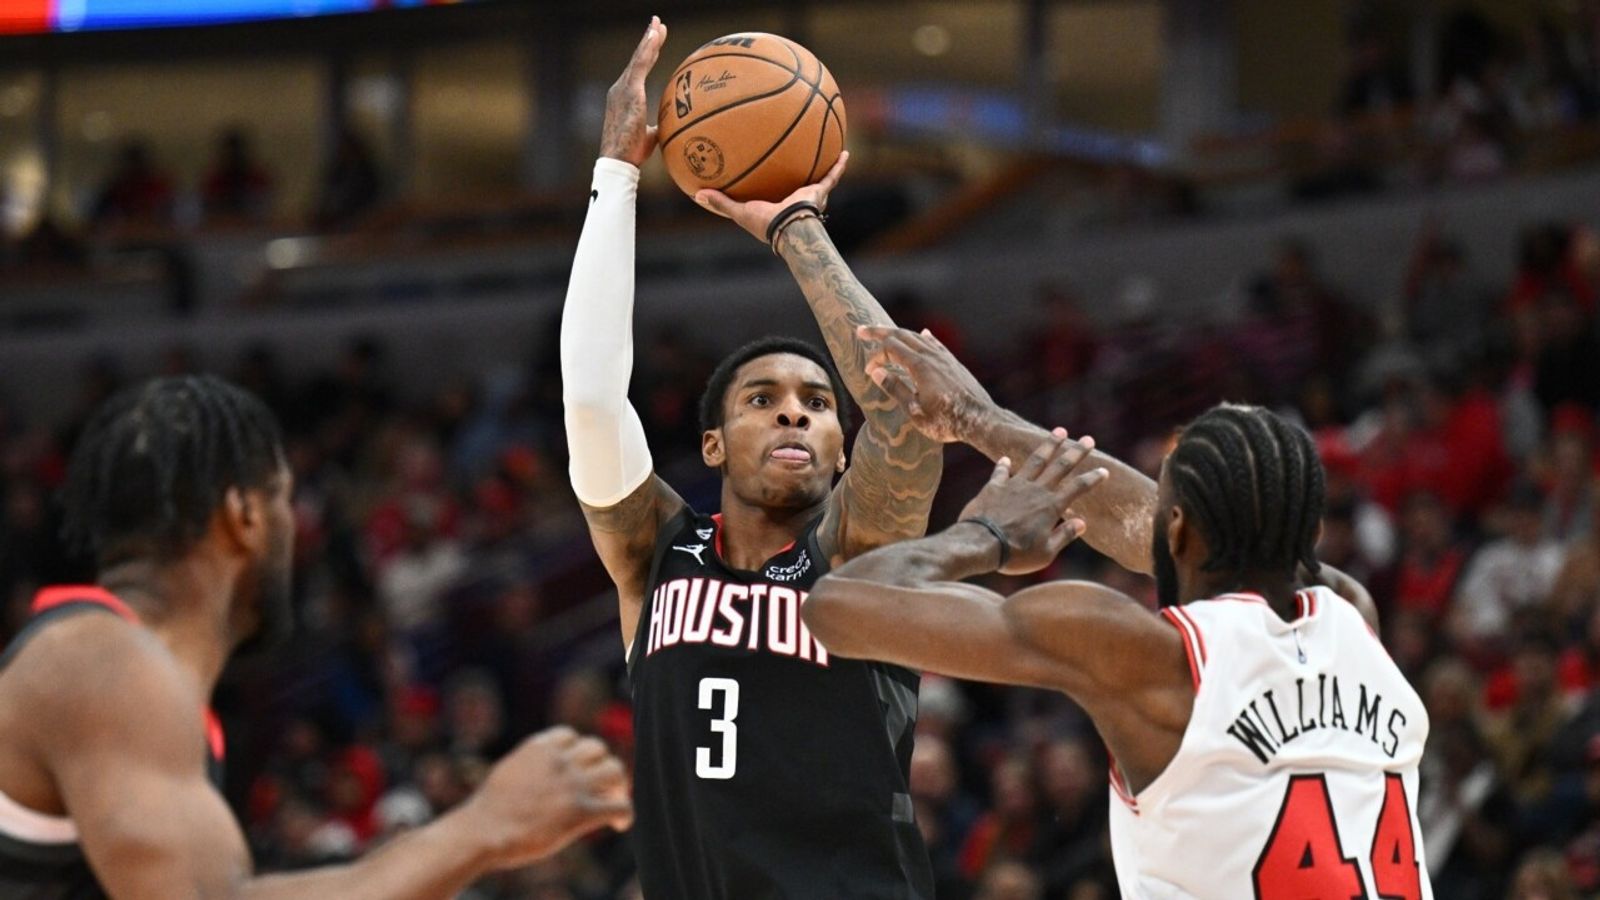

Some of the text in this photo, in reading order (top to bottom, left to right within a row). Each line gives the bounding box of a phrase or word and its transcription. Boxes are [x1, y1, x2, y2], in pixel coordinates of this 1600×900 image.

[770, 549, 807, 573] credit
[696, 677, 739, 779] 3
[1226, 673, 1407, 765] WILLIAMS
[1251, 770, 1423, 900] 44
